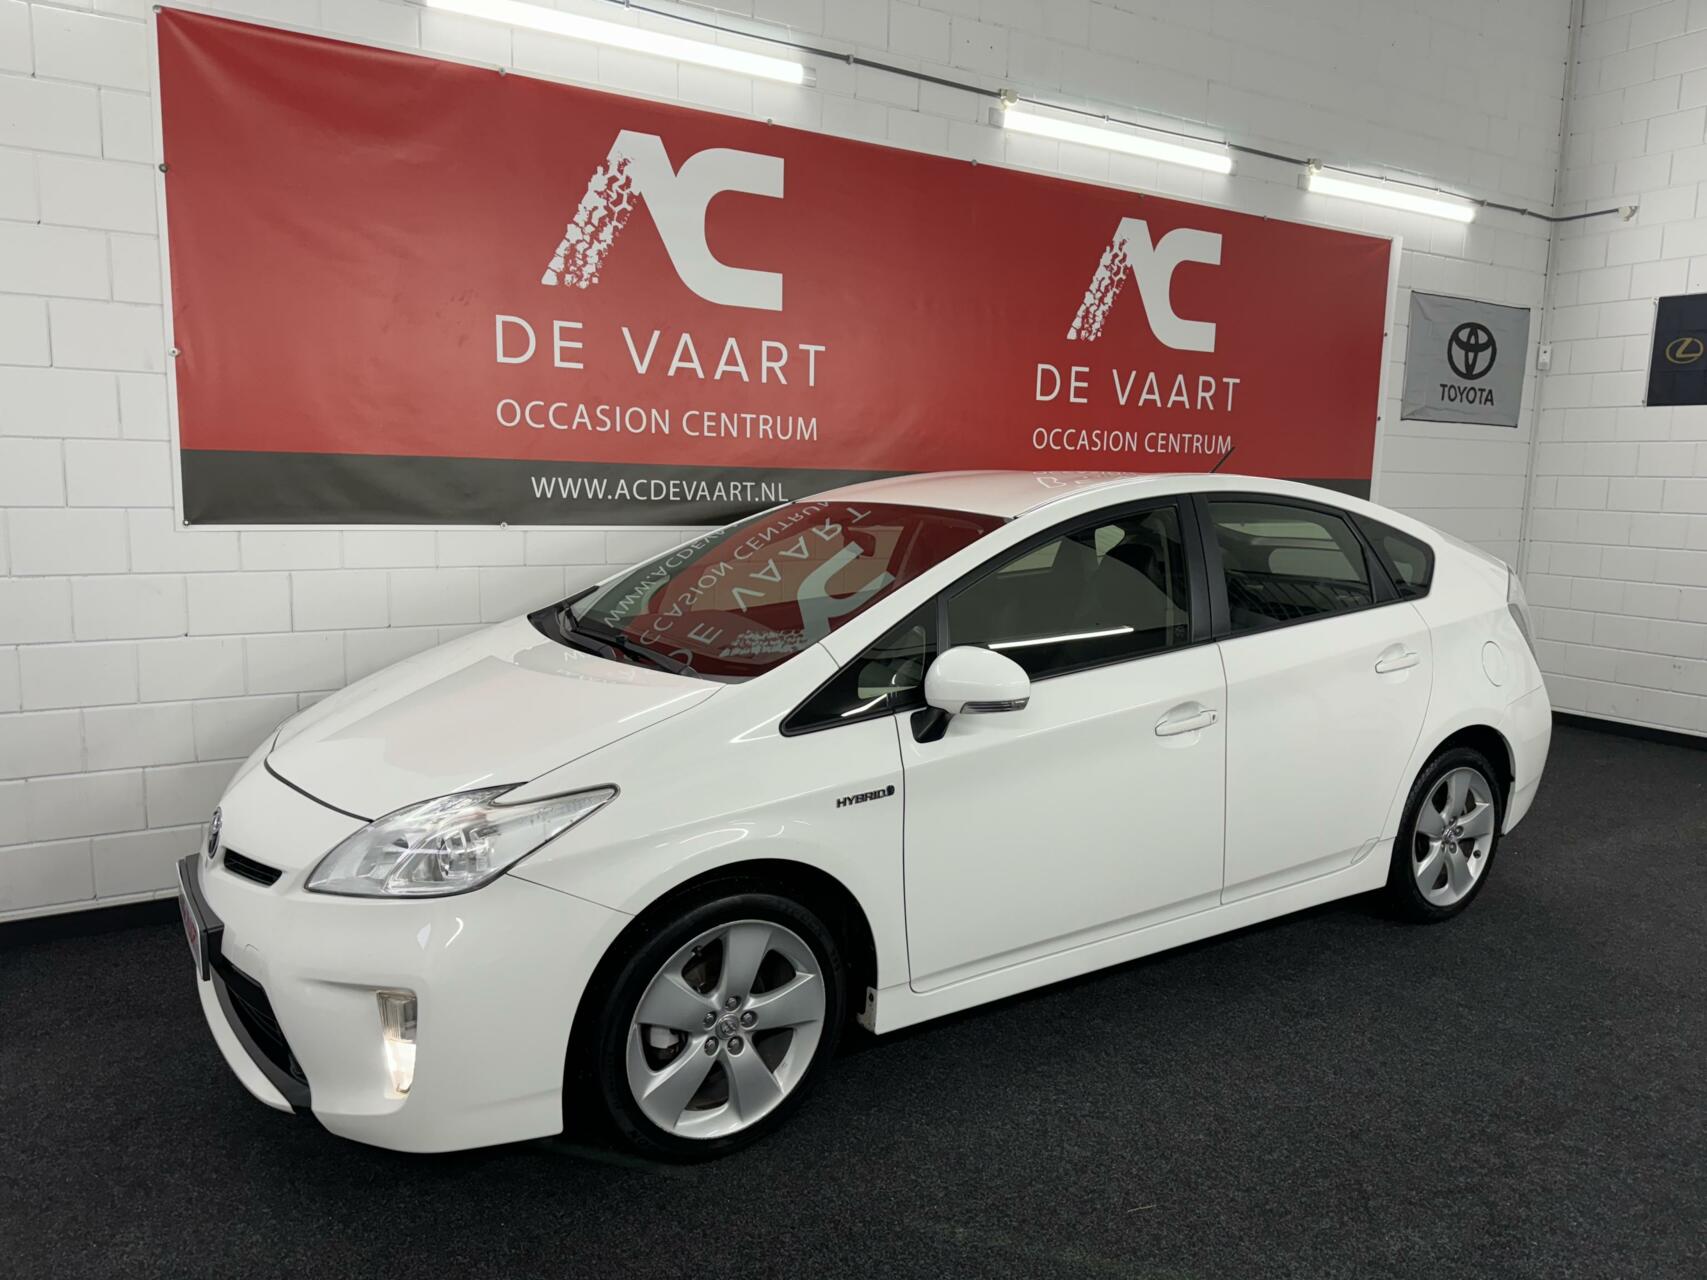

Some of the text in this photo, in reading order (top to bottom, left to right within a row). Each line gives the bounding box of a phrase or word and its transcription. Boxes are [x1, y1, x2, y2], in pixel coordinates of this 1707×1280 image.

[541, 129, 784, 311] AC
[1066, 216, 1222, 352] AC
[495, 314, 825, 387] DE VAART
[1035, 363, 1240, 411] DE VAART
[1439, 383, 1494, 406] TOYOTA
[496, 399, 817, 440] OCCASION CENTRUM
[1032, 427, 1232, 454] OCCASION CENTRUM
[531, 476, 788, 502] WWW.ACDEVAART.NL
[836, 789, 886, 808] HYBRID
